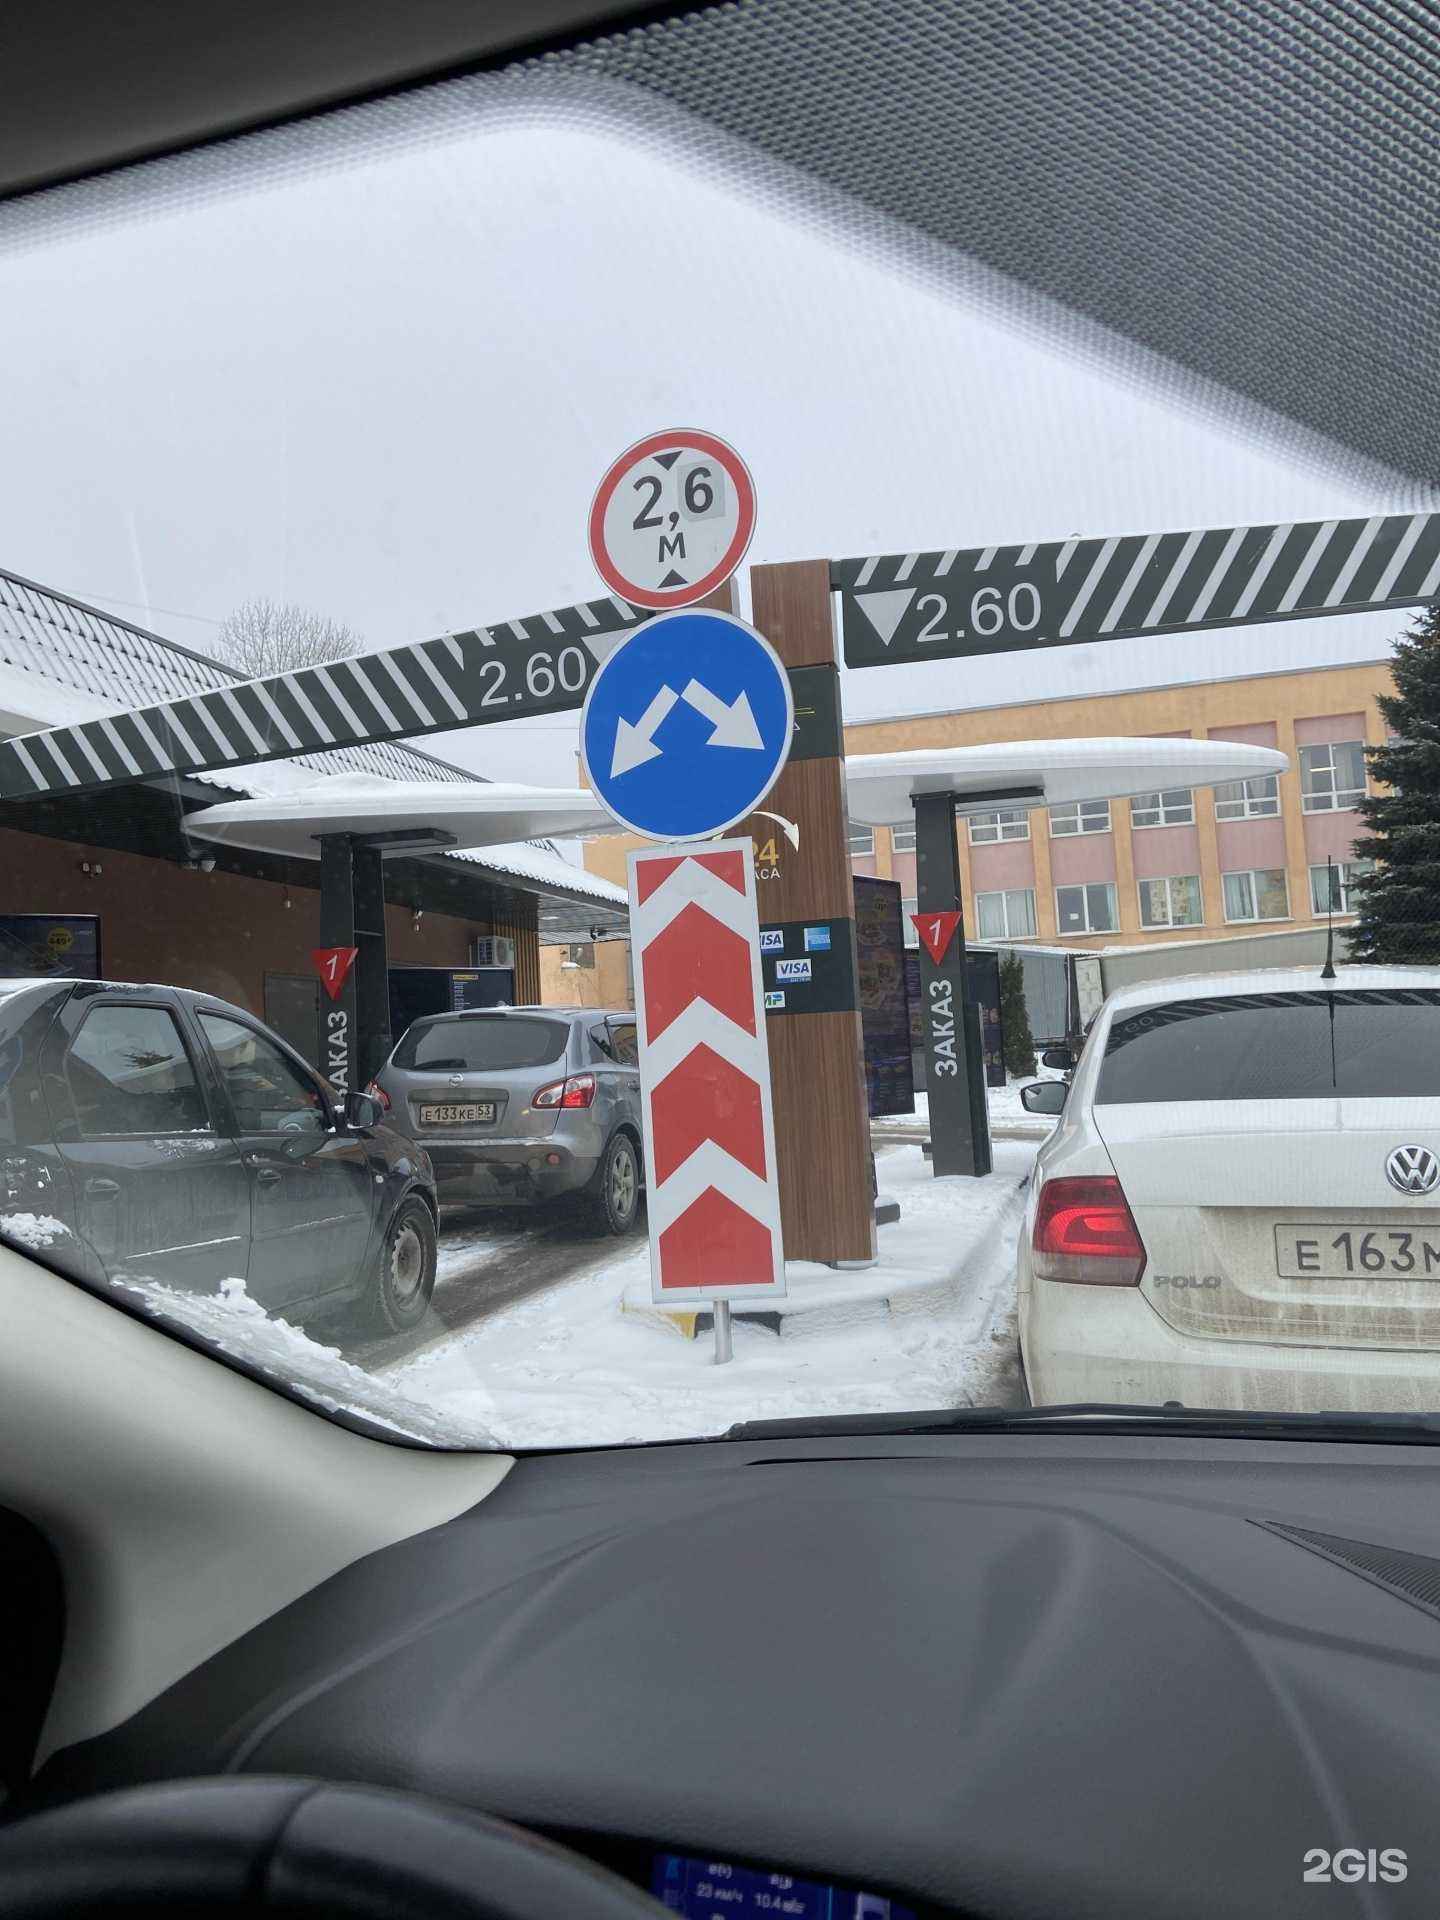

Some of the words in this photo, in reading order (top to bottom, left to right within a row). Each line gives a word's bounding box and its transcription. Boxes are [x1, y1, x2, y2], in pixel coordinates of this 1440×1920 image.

[633, 466, 714, 532] 2,6
[916, 582, 1042, 643] 2.60
[479, 646, 587, 707] 2.60
[760, 933, 782, 946] ISA
[929, 919, 941, 946] 1
[326, 954, 338, 981] 1
[780, 962, 810, 974] VISA
[928, 979, 958, 1078] ЗАКАЗ
[1153, 1275, 1222, 1289] POLO
